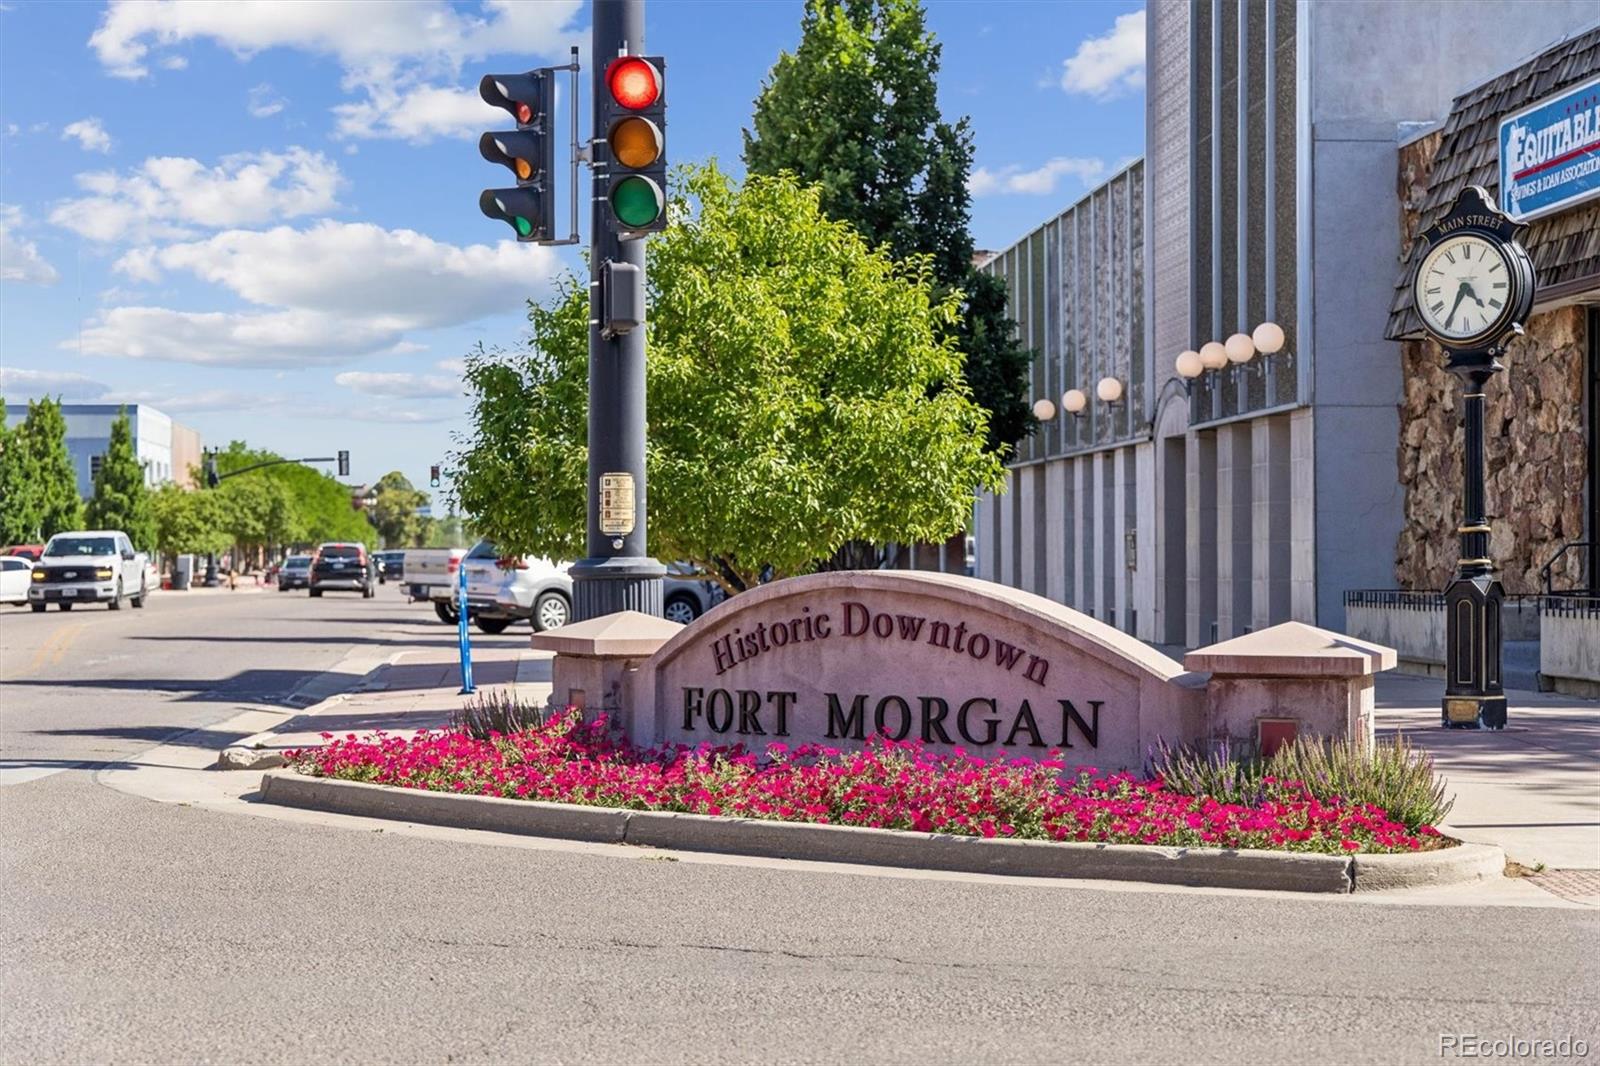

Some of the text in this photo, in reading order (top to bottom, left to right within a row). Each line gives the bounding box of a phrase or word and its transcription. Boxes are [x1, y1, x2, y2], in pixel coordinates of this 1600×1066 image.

[1542, 170, 1561, 192] LOAN
[1438, 214, 1504, 235] MAIN STREET
[710, 602, 1051, 687] Historic Downtown
[682, 687, 1105, 749] FORT MORGAN
